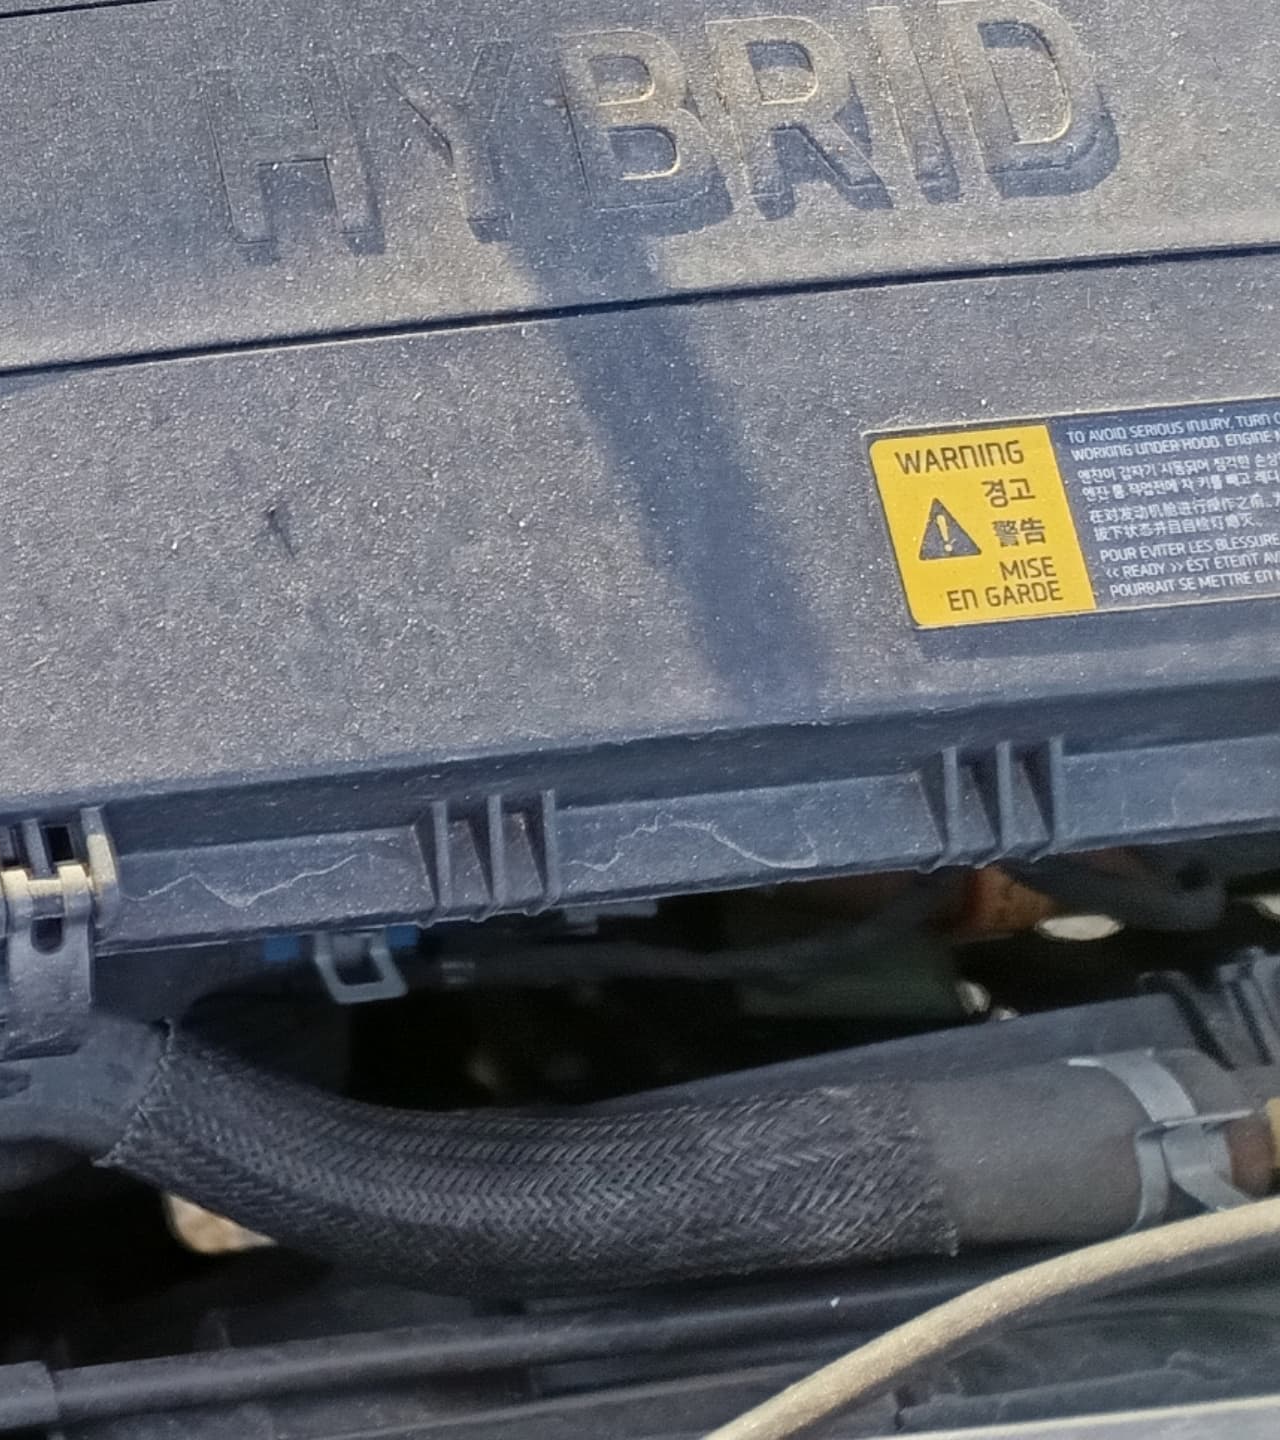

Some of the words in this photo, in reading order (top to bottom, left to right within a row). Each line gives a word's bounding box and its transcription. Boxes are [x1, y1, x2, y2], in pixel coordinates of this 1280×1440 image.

[1066, 431, 1085, 444] TO
[1088, 426, 1127, 441] AVOID
[1129, 421, 1184, 438] SERIOUS
[1234, 413, 1271, 428] TURN
[894, 440, 1025, 475] WARNING
[1070, 444, 1134, 461] WORKING
[1134, 439, 1180, 456] UNDER
[1224, 430, 1273, 447] ENGINE
[1077, 466, 1117, 484] 엔진이
[980, 477, 1037, 509] 경고
[1081, 485, 1110, 502] 엔진
[992, 517, 1046, 548] 警告
[1100, 546, 1138, 562] POUR
[1188, 540, 1213, 554] LES
[999, 556, 1057, 581] MISE
[1109, 579, 1176, 598] POURRAIT
[1178, 577, 1197, 591] SE
[1198, 571, 1253, 589] METTRE
[1254, 569, 1274, 584] EN
[1121, 562, 1165, 579] READY
[946, 588, 979, 612] EN
[984, 580, 1064, 608] GARDE
